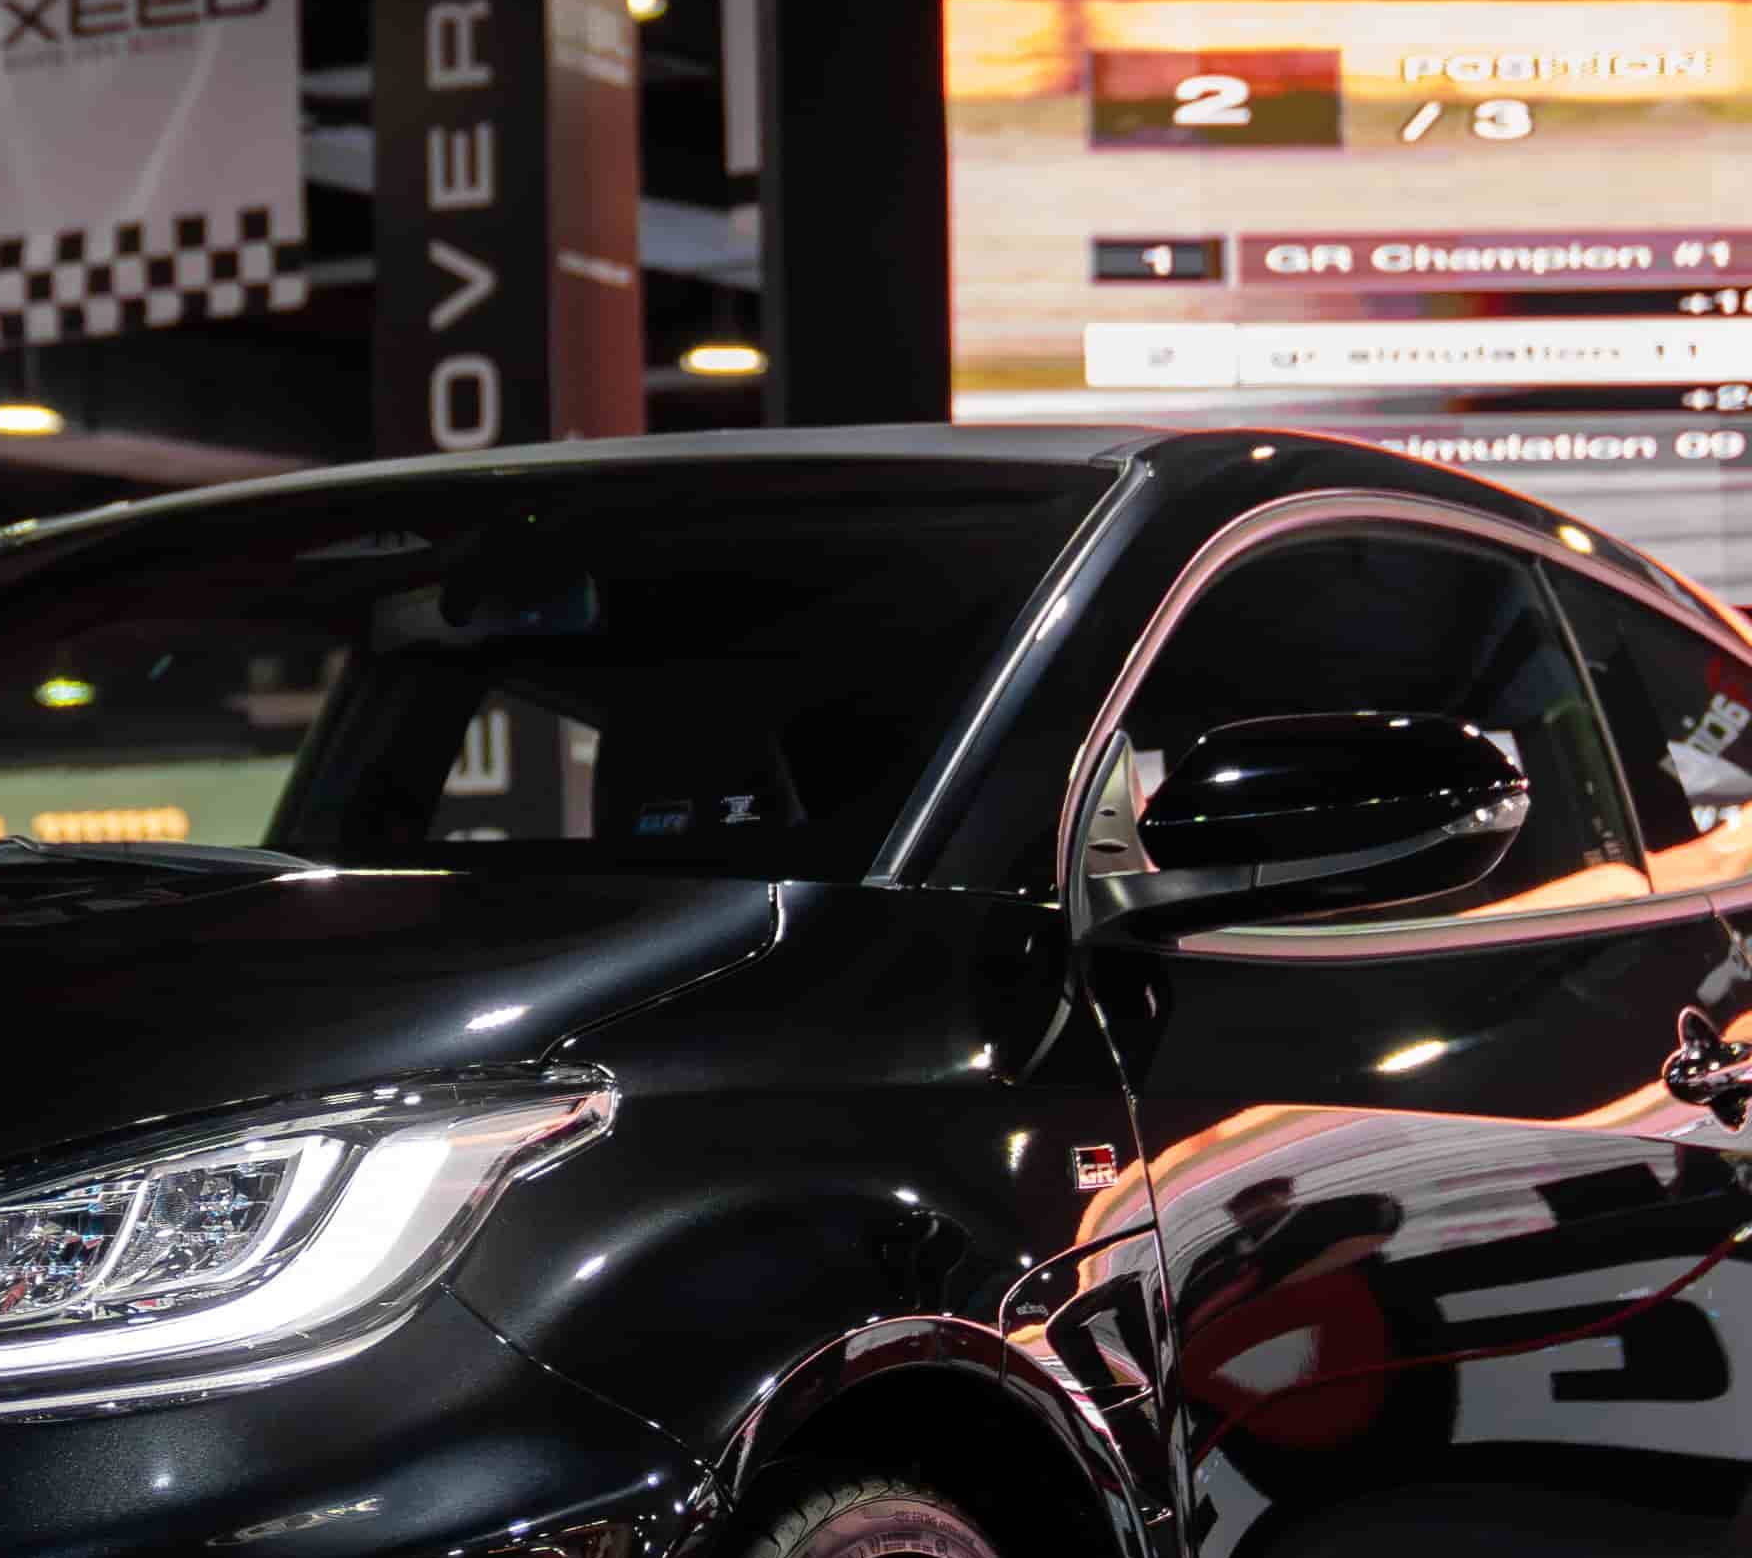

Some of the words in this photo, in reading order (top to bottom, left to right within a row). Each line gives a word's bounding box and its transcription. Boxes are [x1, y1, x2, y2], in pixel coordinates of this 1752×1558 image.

[1173, 75, 1251, 126] 2
[1142, 244, 1173, 276] 1
[1264, 244, 1353, 274] GR
[1371, 242, 1653, 275] Champion
[1672, 241, 1731, 269] #1
